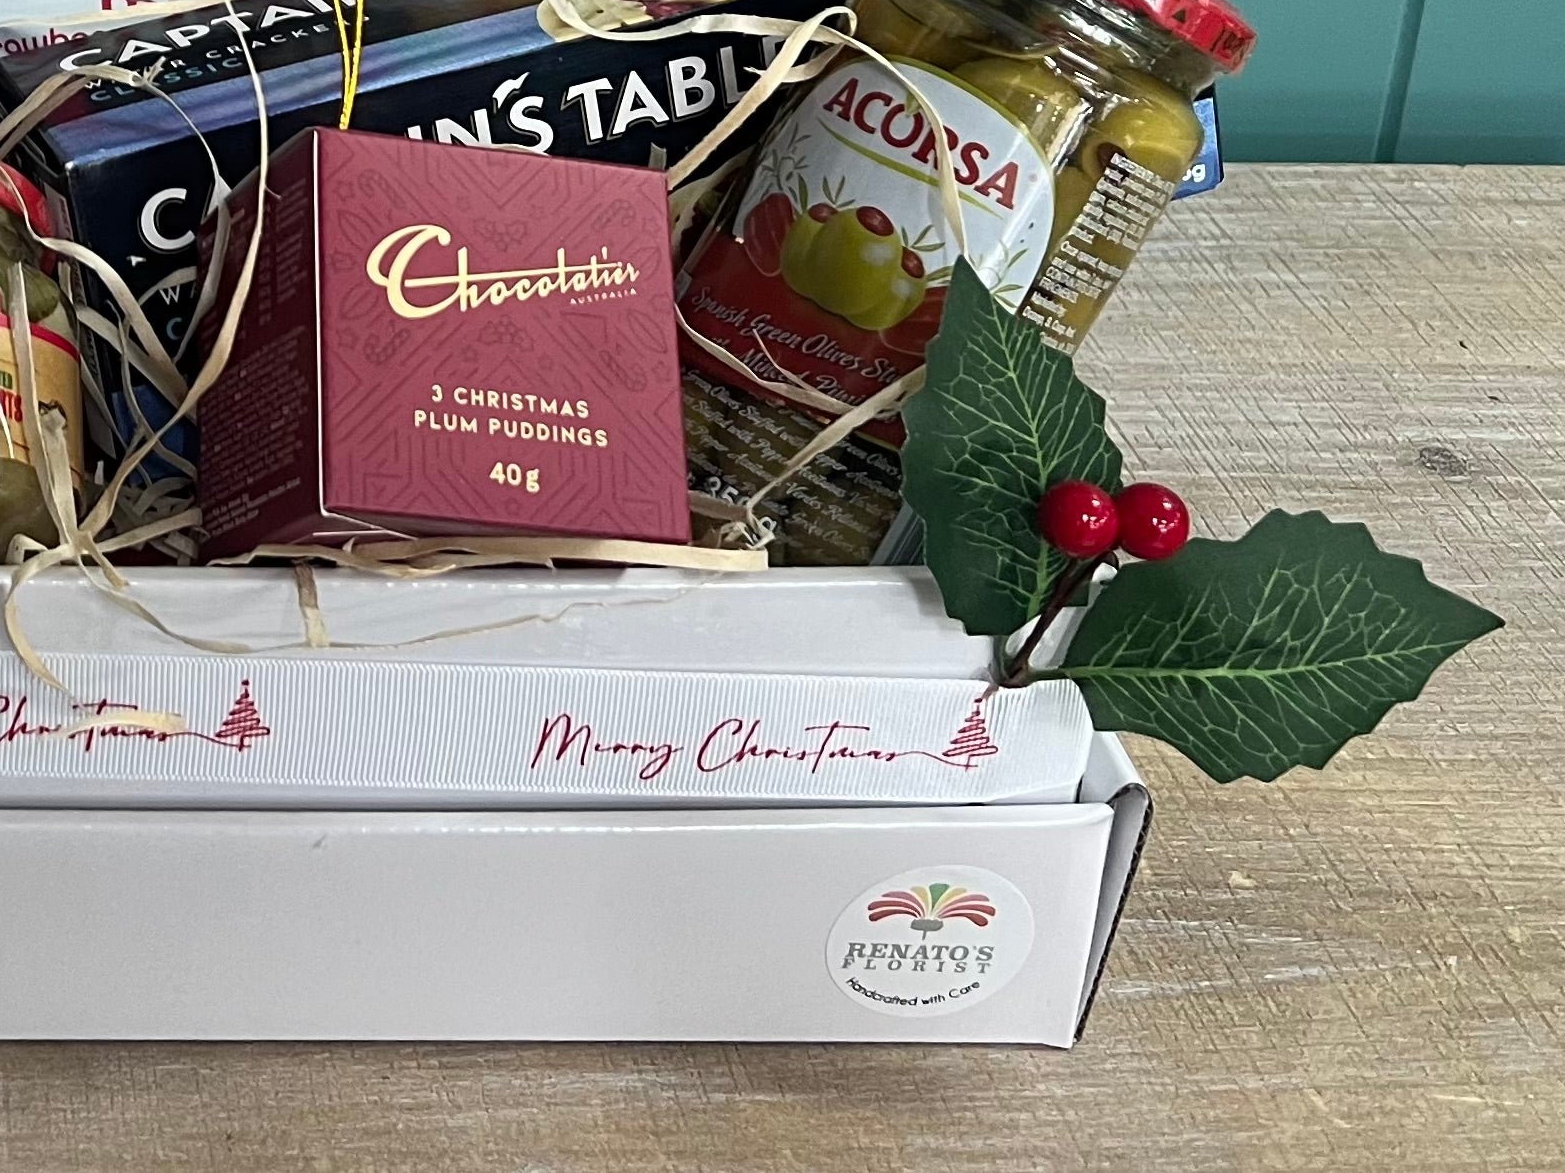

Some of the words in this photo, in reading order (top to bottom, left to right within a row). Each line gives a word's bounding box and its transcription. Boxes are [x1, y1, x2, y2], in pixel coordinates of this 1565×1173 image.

[823, 77, 1019, 212] ACORSA
[366, 224, 641, 320] Chocolatier
[569, 287, 638, 306] AUSTRALIA
[692, 287, 749, 327] Spanish
[742, 313, 802, 350] Green
[801, 333, 865, 371] Olives
[431, 384, 444, 404] 3
[452, 386, 591, 420] CHRISTMAS
[413, 409, 479, 436] PLUM
[488, 417, 610, 449] PUDDINGS
[489, 461, 541, 494] 40g
[531, 713, 684, 780] Merry
[696, 717, 903, 777] Christmas
[841, 957, 994, 975] FLORIST
[845, 941, 996, 963] RENATO'S
[845, 977, 919, 1007] Handcrafted
[920, 993, 947, 1006] with
[948, 980, 981, 999] Care
